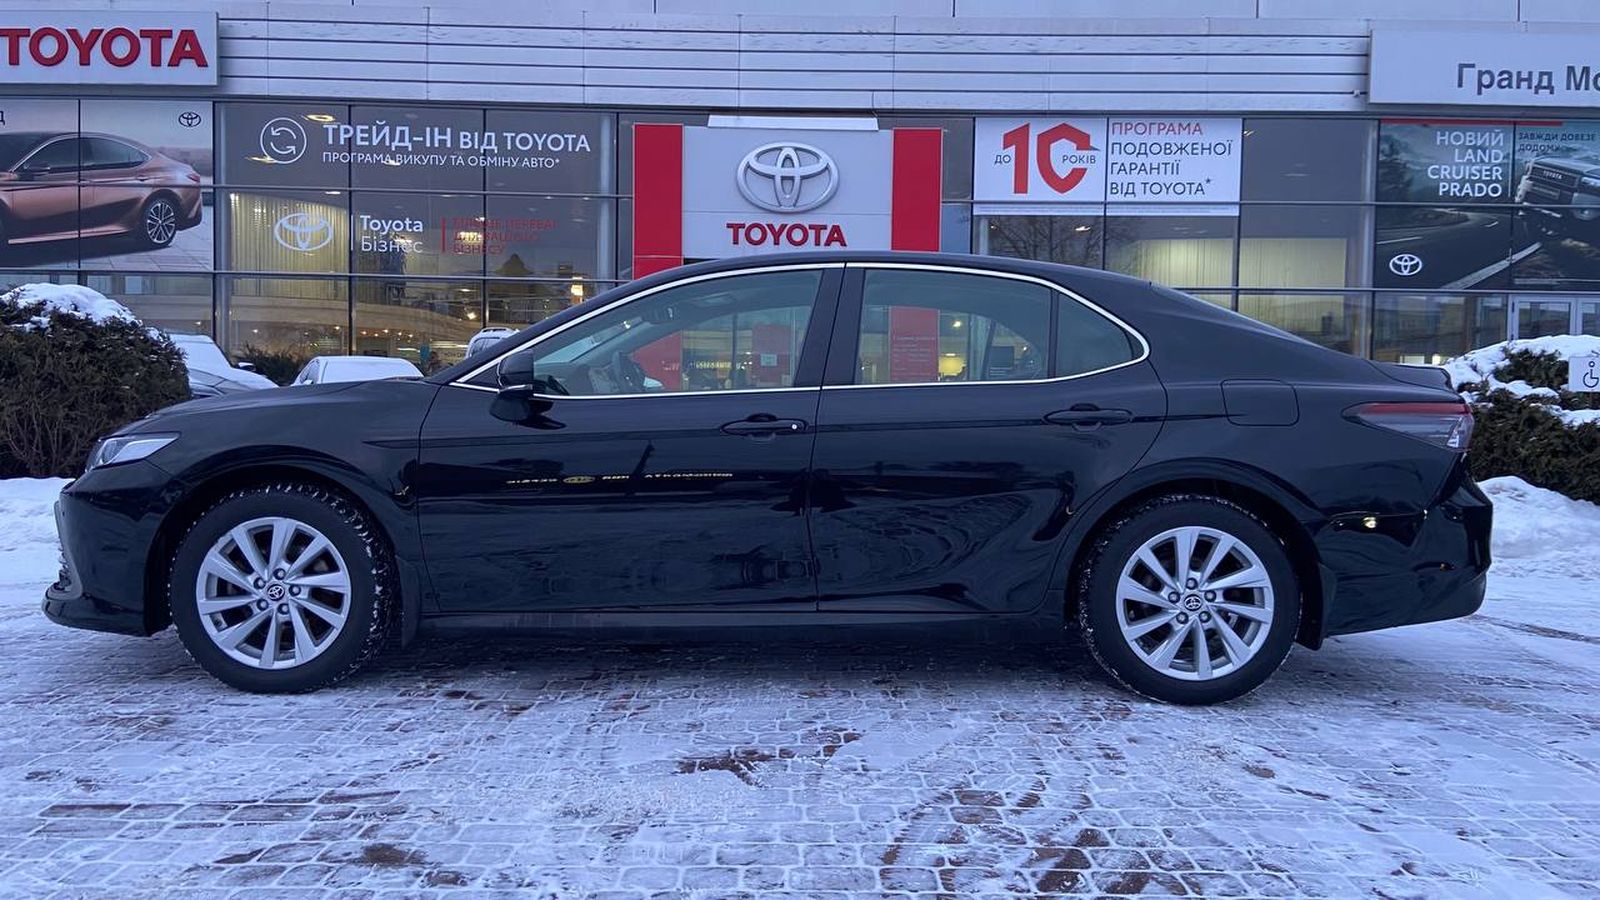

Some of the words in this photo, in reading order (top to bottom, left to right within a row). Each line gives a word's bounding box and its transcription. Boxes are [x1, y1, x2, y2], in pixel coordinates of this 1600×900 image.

[0, 26, 208, 68] TOYOTA
[1457, 63, 1554, 96] Гранд
[323, 119, 451, 151] ТРЕЙД-ІН
[459, 131, 497, 154] ВІД
[504, 132, 591, 153] TOYOTA
[1111, 122, 1203, 136] ПРОГРАМА
[1436, 128, 1504, 146] НОВИЙ
[1518, 131, 1558, 142] ЗАВЖДИ
[1110, 139, 1233, 158] ПОДОВЖЕНОЇ
[1454, 148, 1504, 164] LAND
[322, 151, 391, 165] ПРОГРАМА
[396, 154, 447, 167] ВИКУПУ
[450, 155, 465, 167] ТА
[468, 155, 519, 168] ОБМІНУ
[994, 154, 1011, 165] ДО
[1062, 154, 1096, 164] РОКІВ
[1110, 159, 1180, 175] ГАРАНТІЇ
[1427, 165, 1503, 181] CRUISER
[1110, 181, 1136, 198] ВІД
[1438, 182, 1503, 198] PRADO
[359, 214, 423, 235] Toyota
[726, 222, 847, 247] TOYOTA
[361, 235, 423, 253] Бізнес
